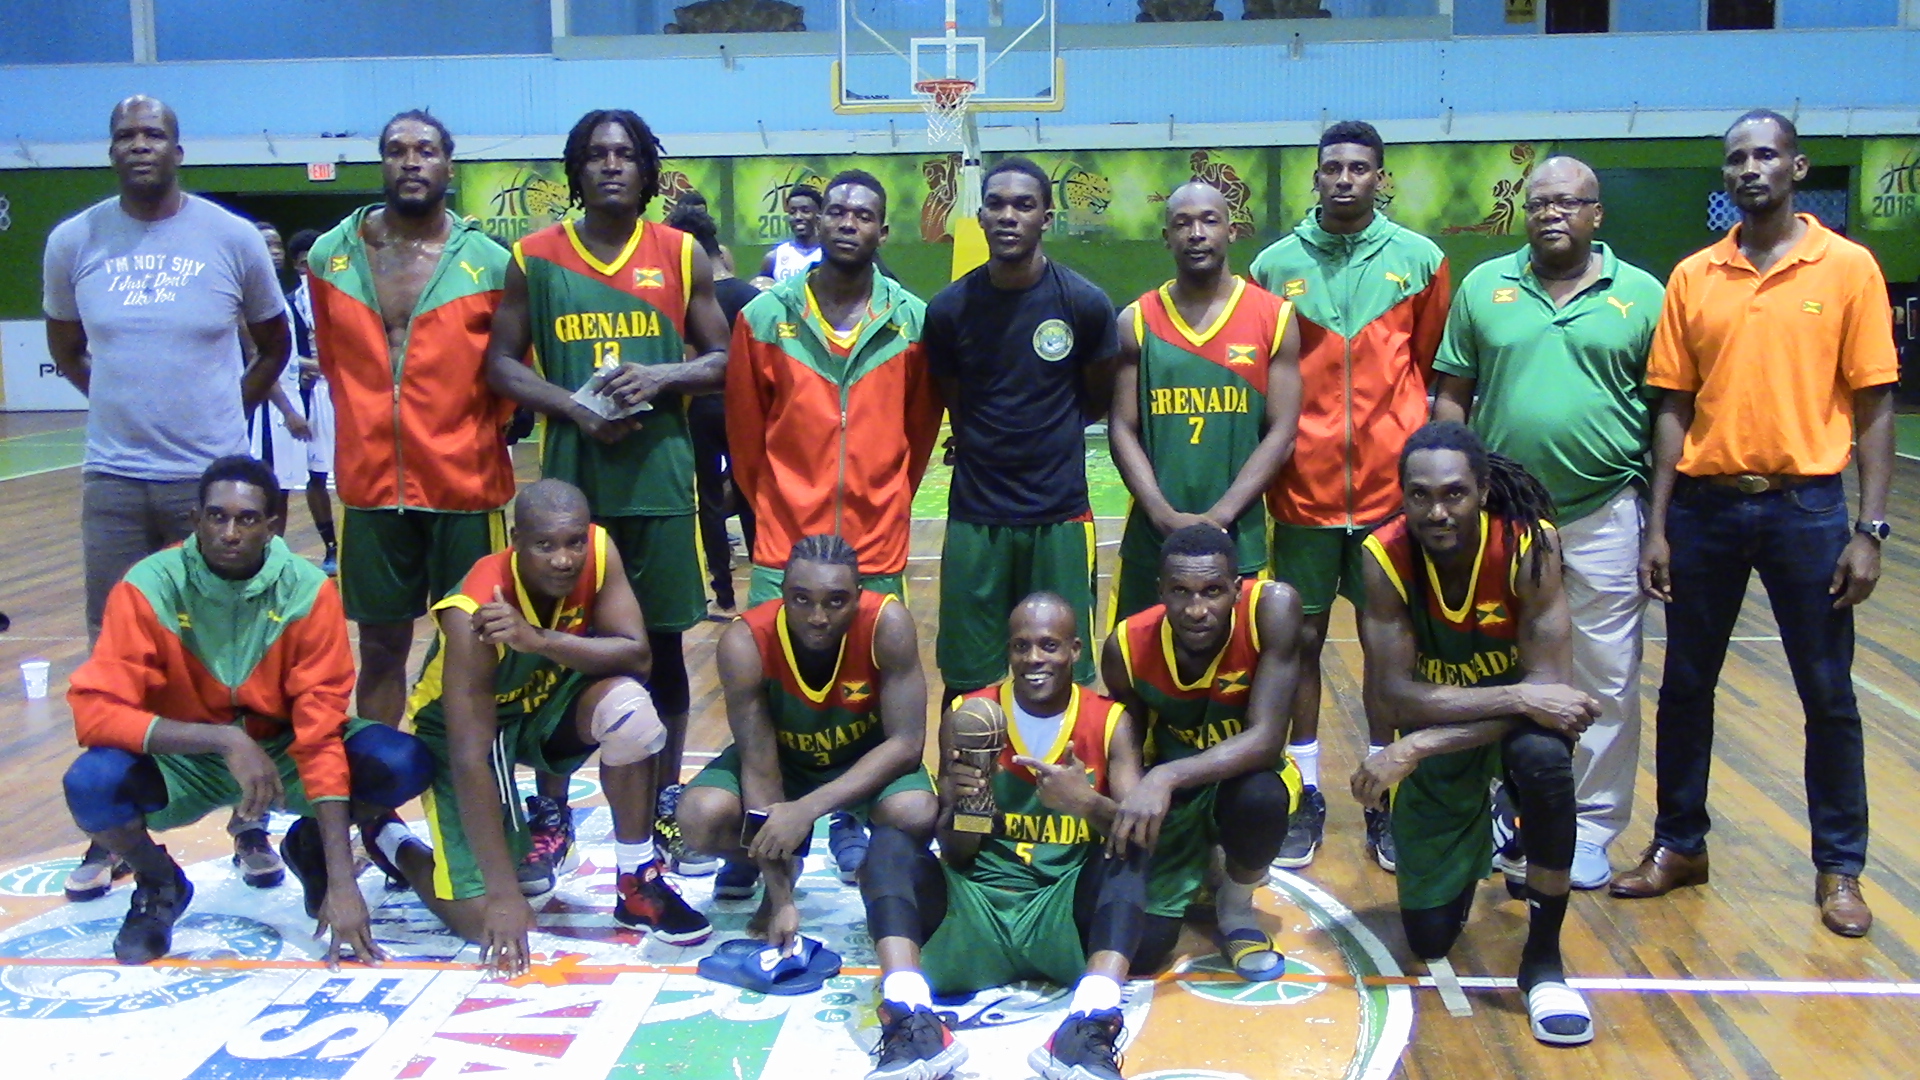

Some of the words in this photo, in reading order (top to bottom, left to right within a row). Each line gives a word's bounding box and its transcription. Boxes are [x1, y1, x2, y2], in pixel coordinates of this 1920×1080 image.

[312, 164, 331, 179] EXIT
[133, 254, 167, 271] NOT
[171, 256, 206, 276] SHY
[118, 274, 155, 292] Just
[123, 290, 152, 305] Like
[154, 287, 177, 303] You
[554, 310, 661, 343] GRENADA
[1188, 416, 1205, 445] 7
[1004, 812, 1091, 845] ENADA
[1015, 841, 1035, 866] 5
